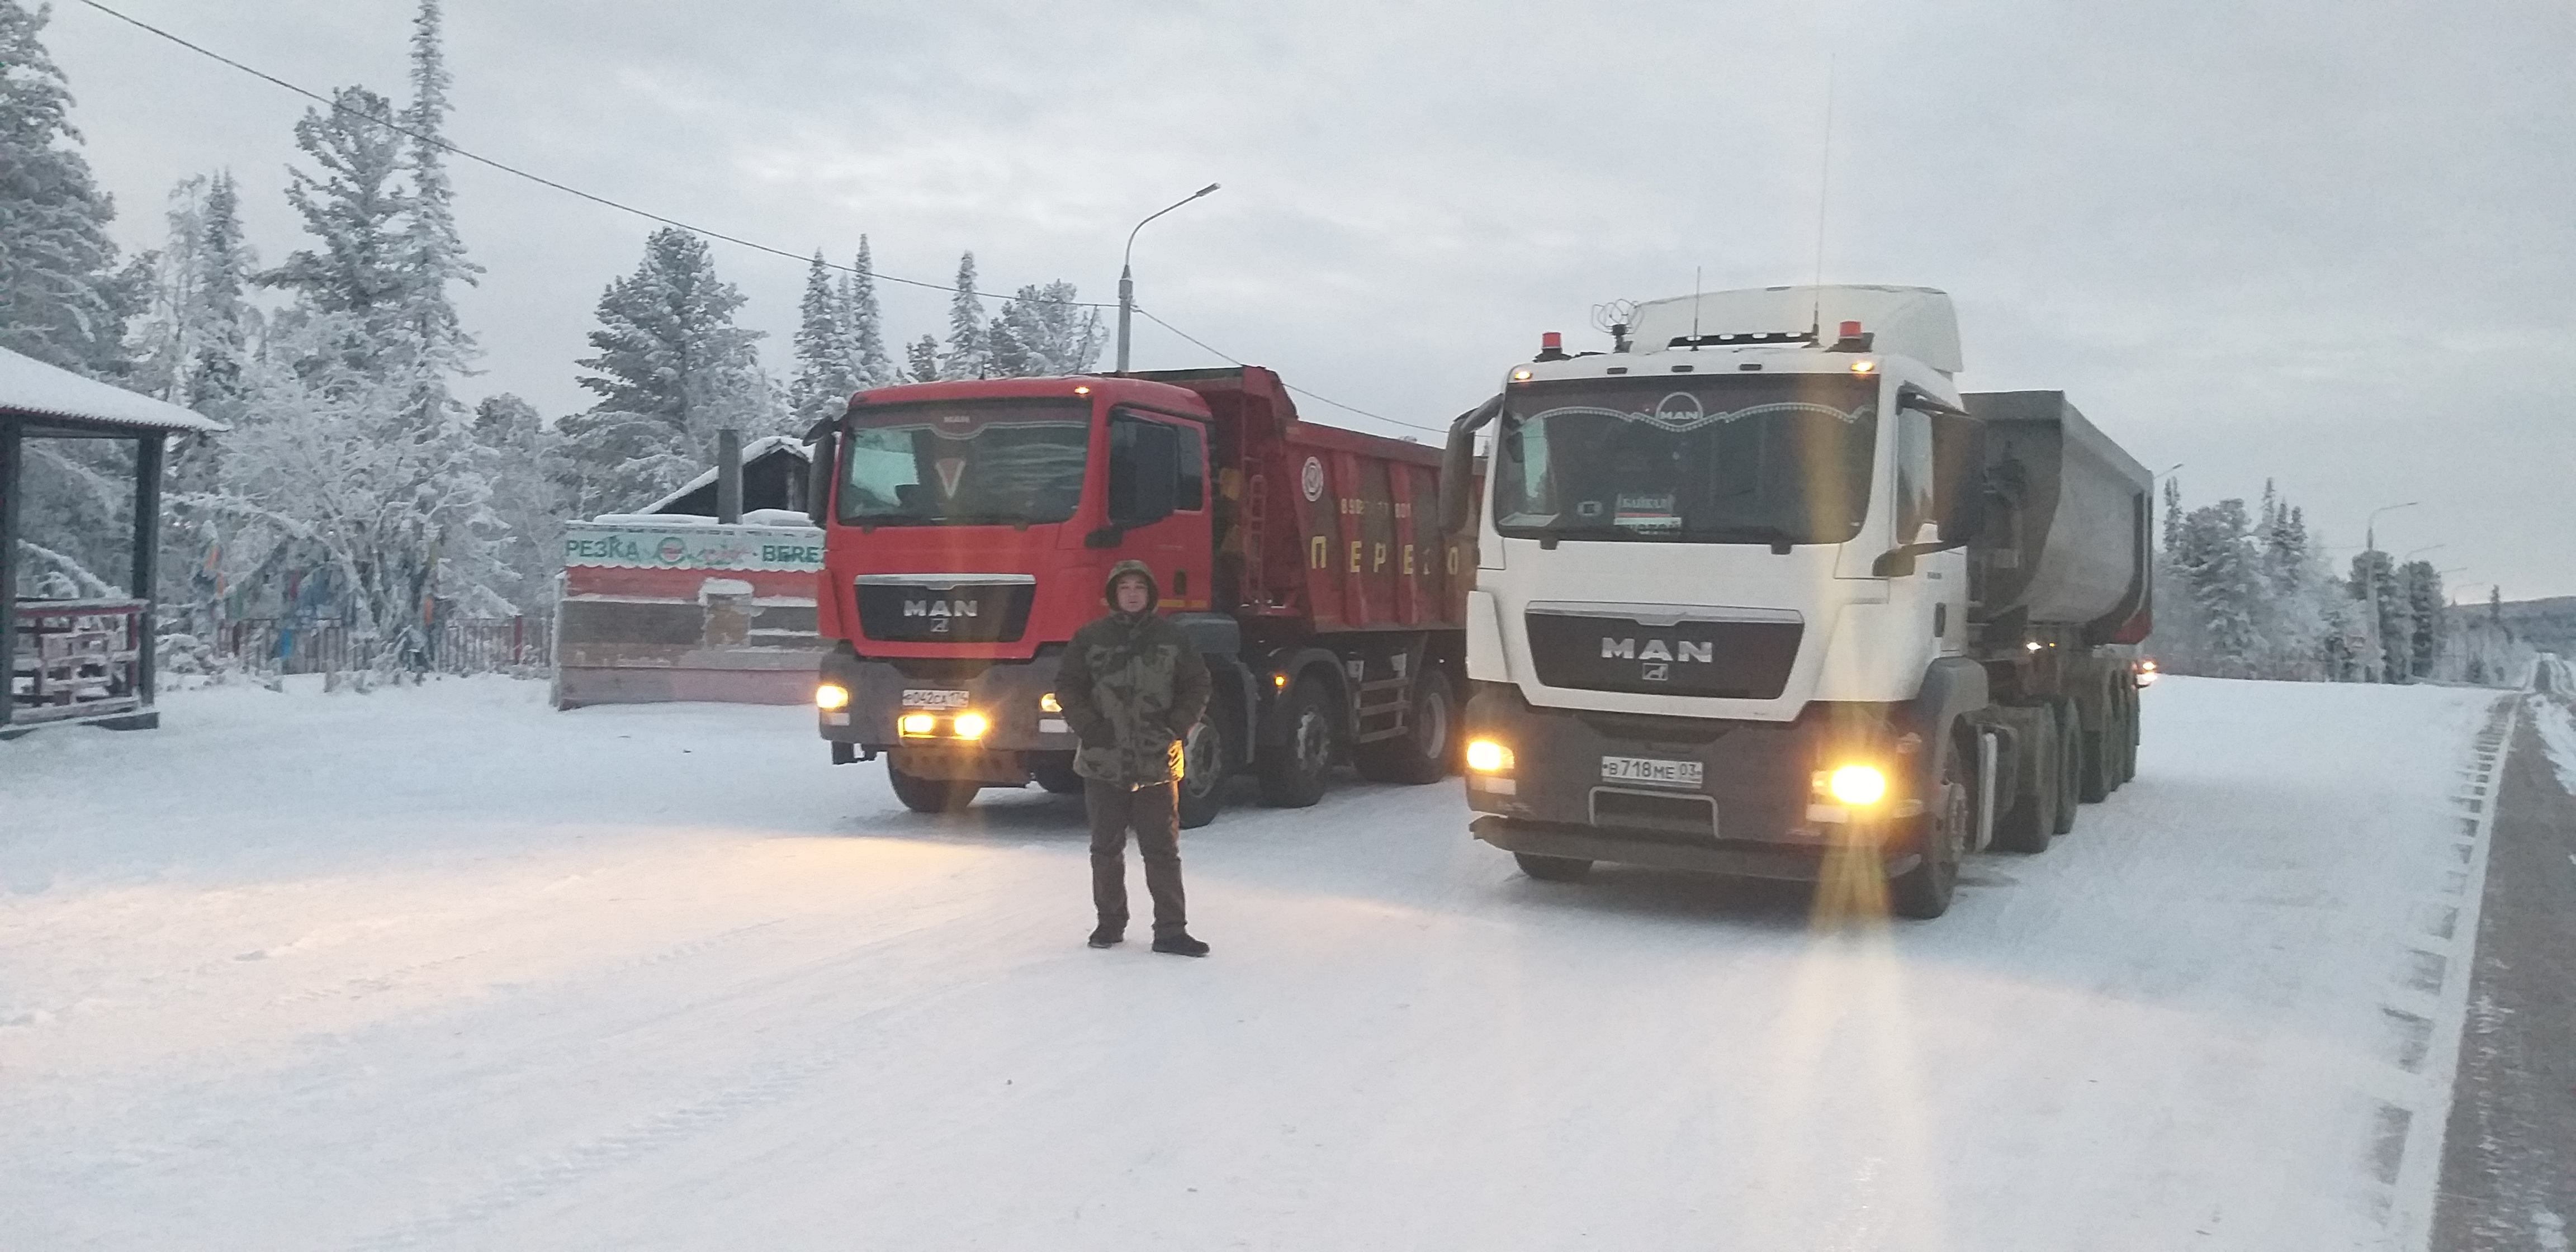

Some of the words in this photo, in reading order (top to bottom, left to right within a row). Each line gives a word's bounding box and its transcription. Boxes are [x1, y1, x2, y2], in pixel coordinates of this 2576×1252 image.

[1660, 411, 1698, 420] MAN
[763, 545, 823, 563] BERE
[1311, 535, 1459, 575] ПЕРЕО
[903, 600, 978, 616] MAN
[1601, 637, 1712, 663] MAN
